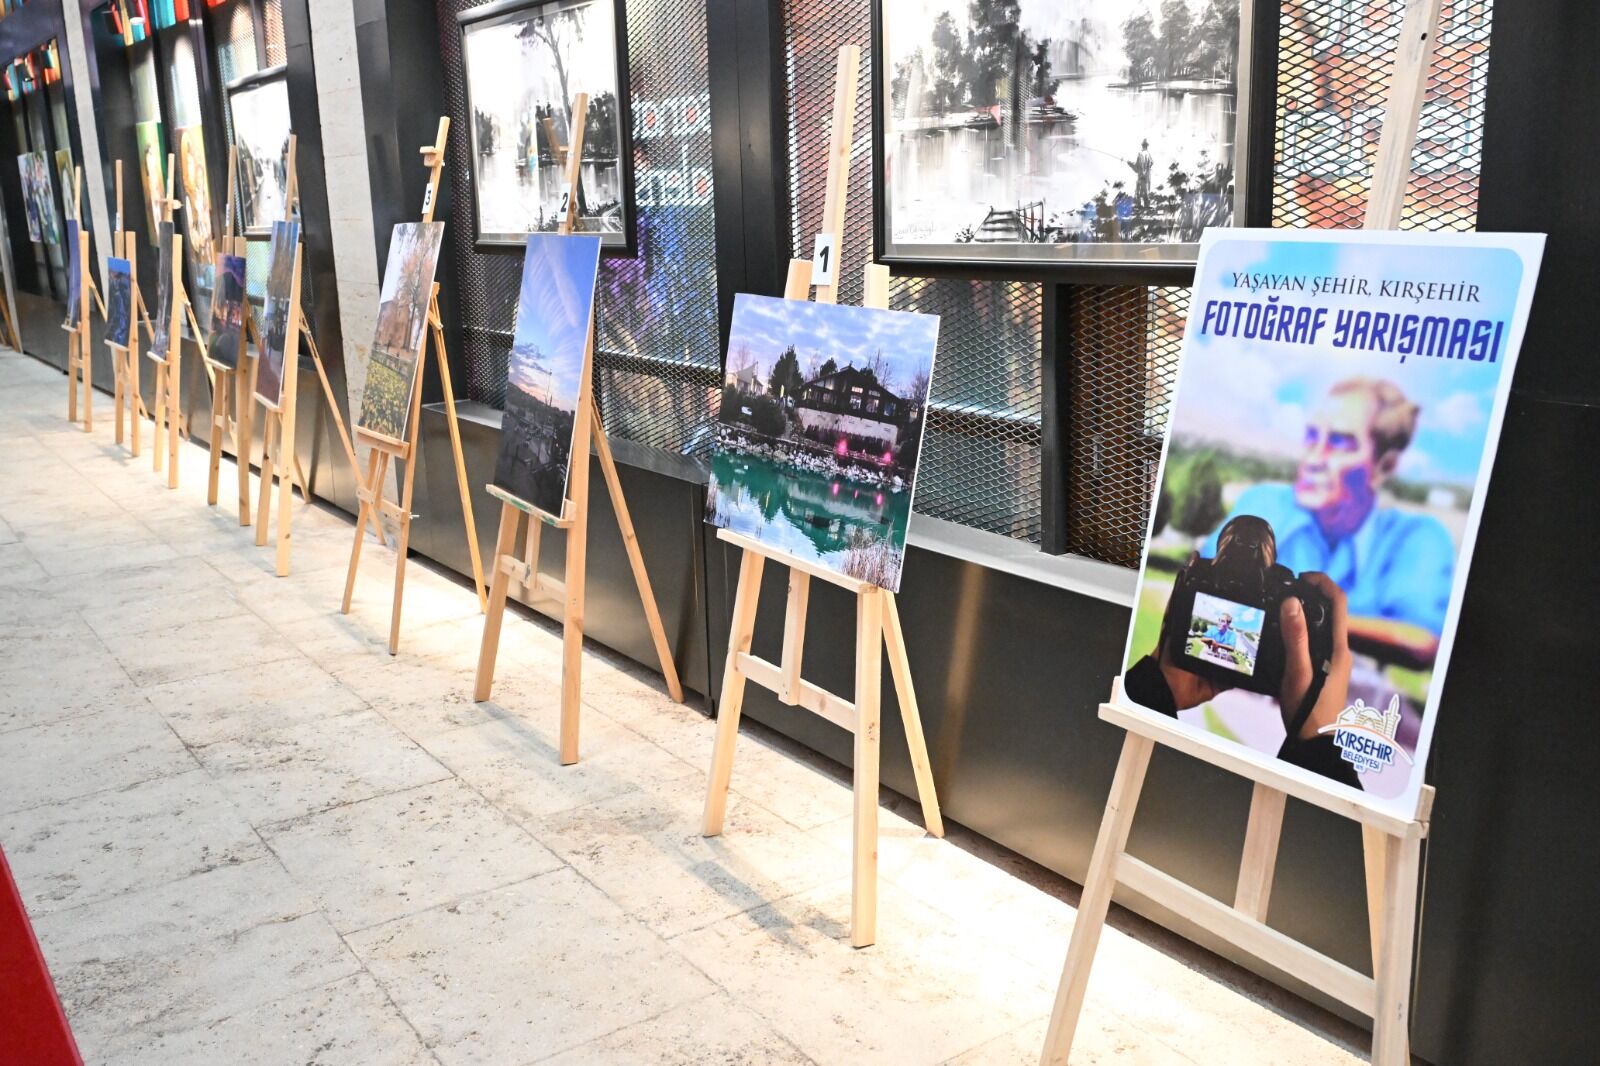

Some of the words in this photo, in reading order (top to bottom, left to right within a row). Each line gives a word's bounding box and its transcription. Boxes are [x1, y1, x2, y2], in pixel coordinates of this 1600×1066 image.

[560, 192, 569, 213] 2
[819, 245, 830, 273] 1
[1232, 272, 1306, 293] YAŞAYAN
[1312, 275, 1373, 298] ŞEHİR,
[1379, 280, 1481, 304] KIRŞEHİR
[1200, 296, 1329, 345] FOTOĞRAF
[1332, 309, 1504, 364] YARIŞMASI
